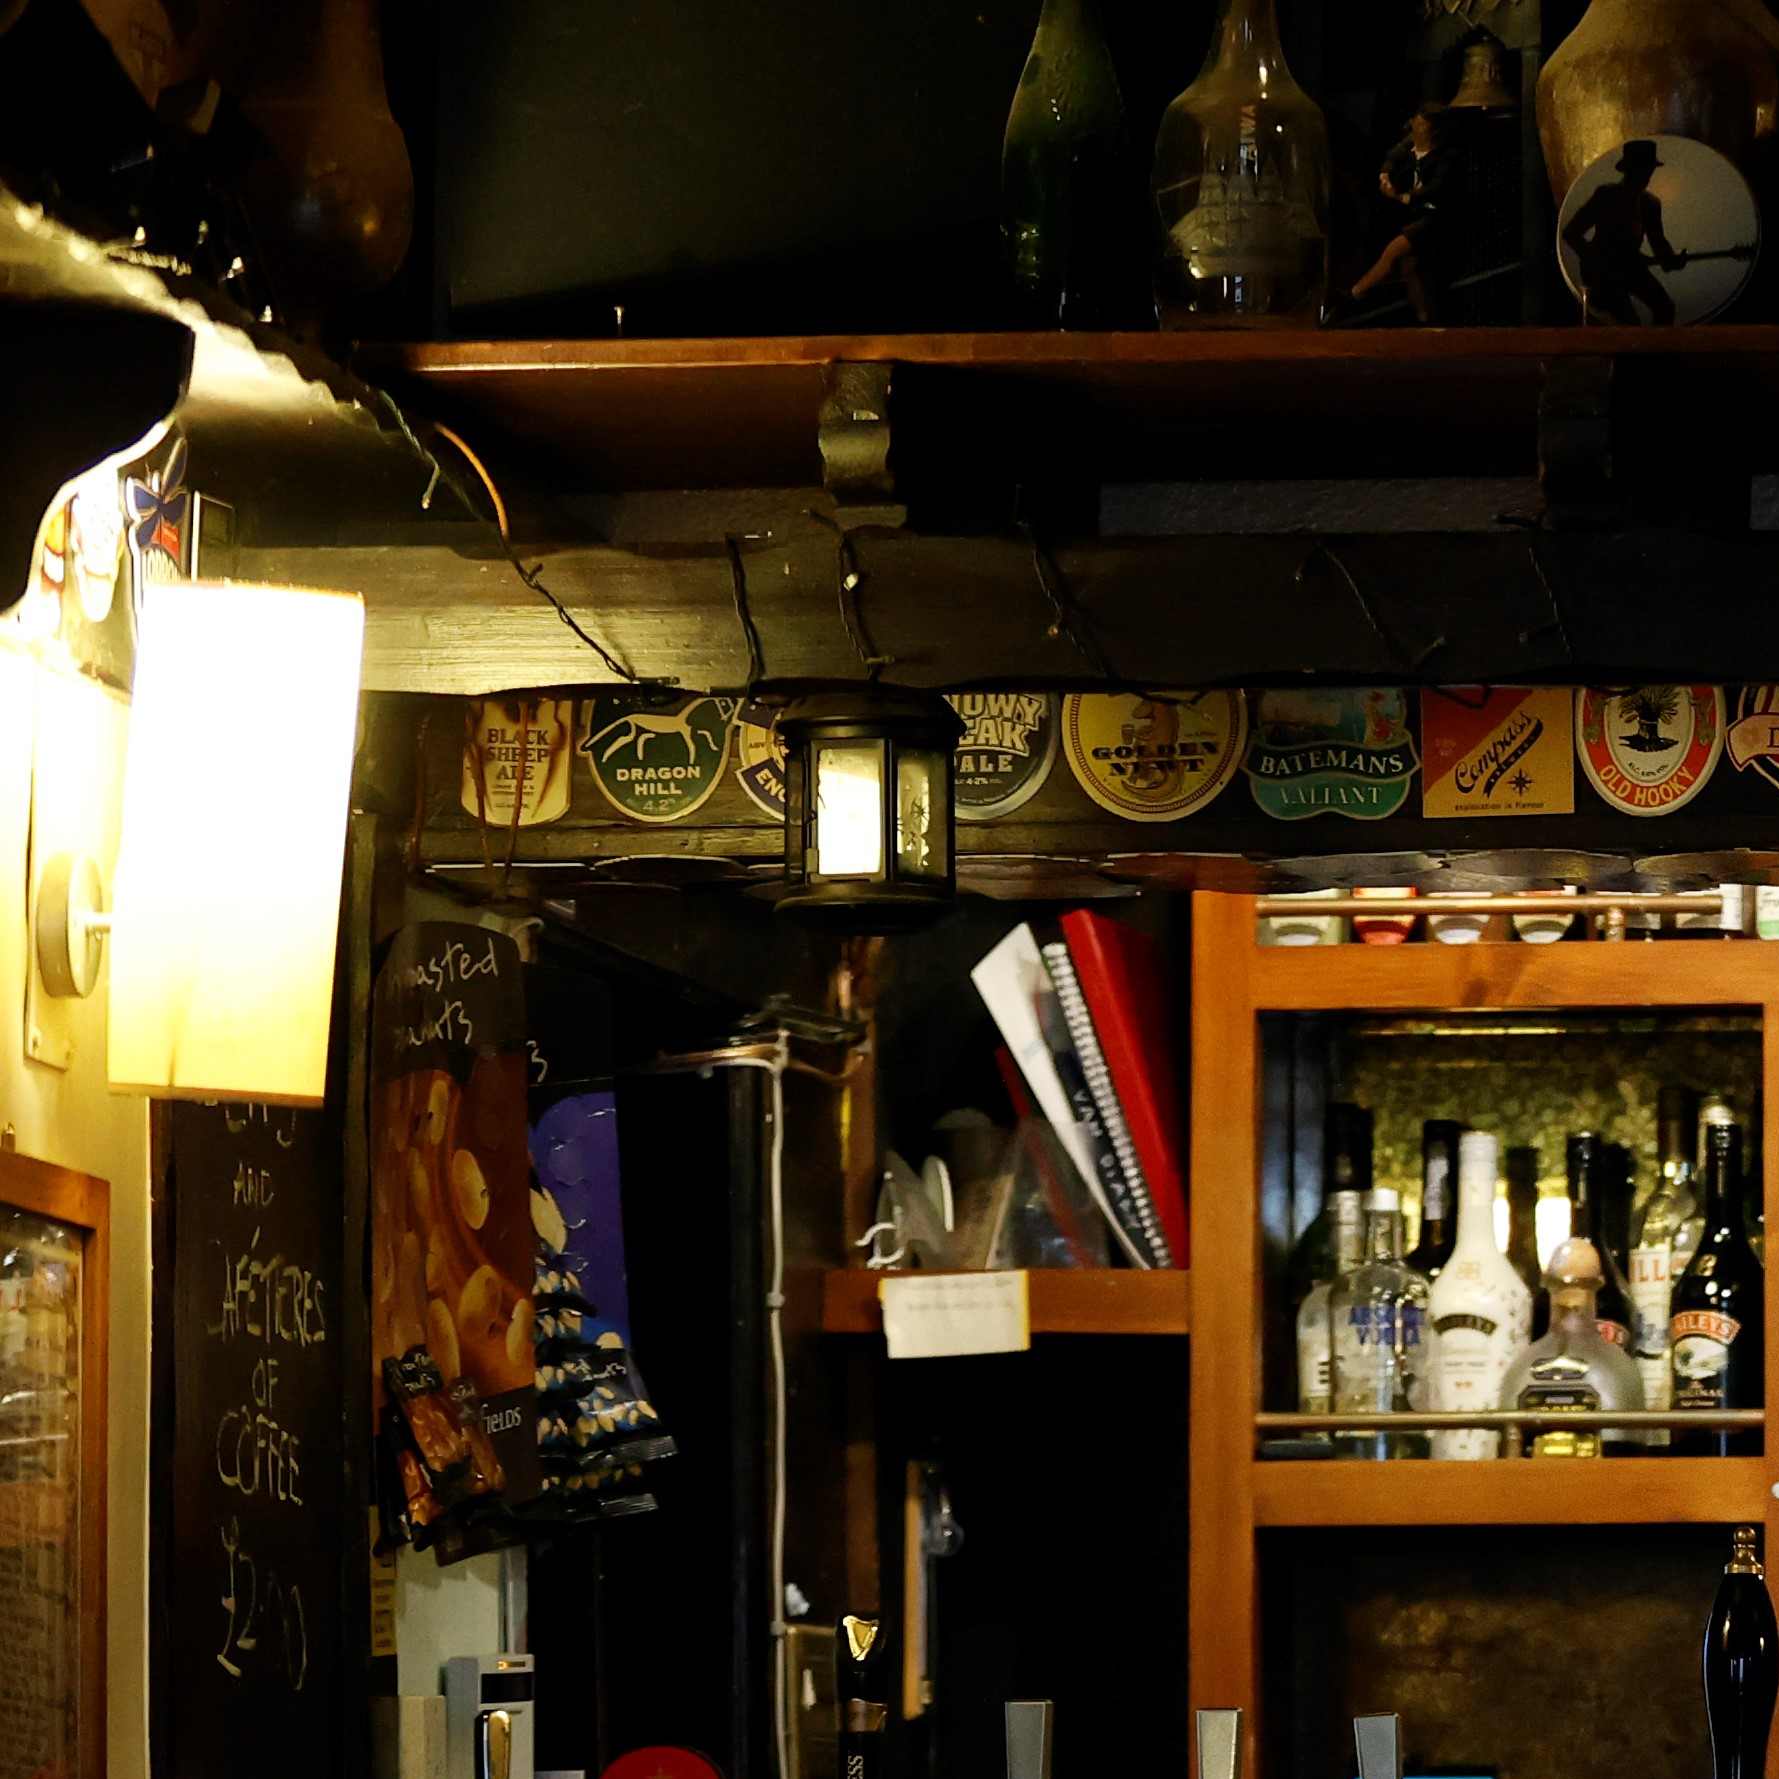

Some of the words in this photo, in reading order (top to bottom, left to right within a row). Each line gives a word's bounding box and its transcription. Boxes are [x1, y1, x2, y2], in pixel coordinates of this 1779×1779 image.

[487, 727, 550, 746] BLACK
[487, 747, 549, 763] SHEEP
[1091, 741, 1218, 760] GOLDEN
[1453, 712, 1535, 795] Compass
[1108, 759, 1205, 777] NEWT
[1260, 745, 1404, 777] BATEMANS
[496, 765, 536, 782] ALE
[616, 766, 701, 783] DRAGON
[634, 781, 683, 797] HILL
[1280, 784, 1382, 806] VALIANT
[1599, 764, 1632, 796] OLD
[1633, 767, 1695, 807] HOOKY
[250, 1354, 280, 1411] OF
[215, 1403, 306, 1508] COFFEE
